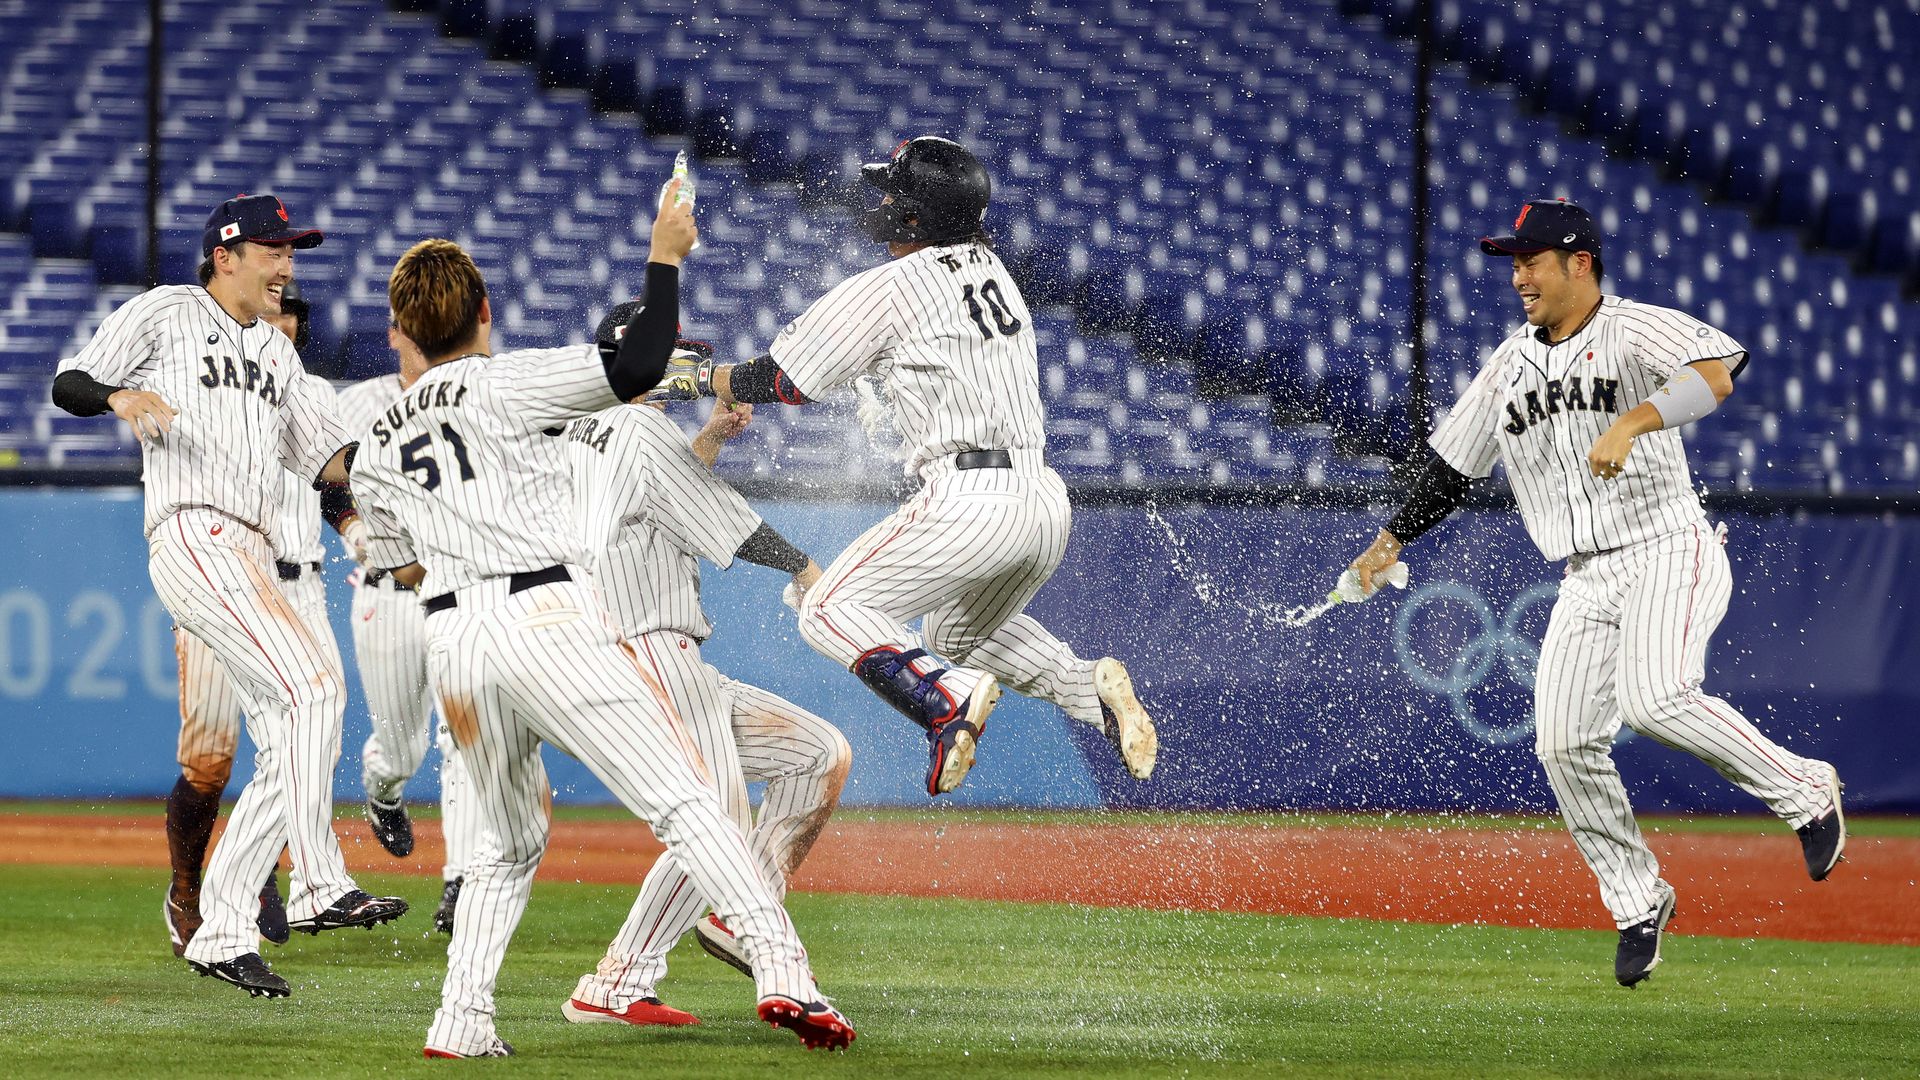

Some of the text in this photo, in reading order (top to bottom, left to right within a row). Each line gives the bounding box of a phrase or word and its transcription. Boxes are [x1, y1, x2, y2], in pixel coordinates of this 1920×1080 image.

[962, 278, 1021, 341] 10
[199, 355, 284, 408] JAPA
[1504, 376, 1619, 436] JAPAN
[372, 380, 468, 448] SUZUKI
[399, 421, 476, 492] 51
